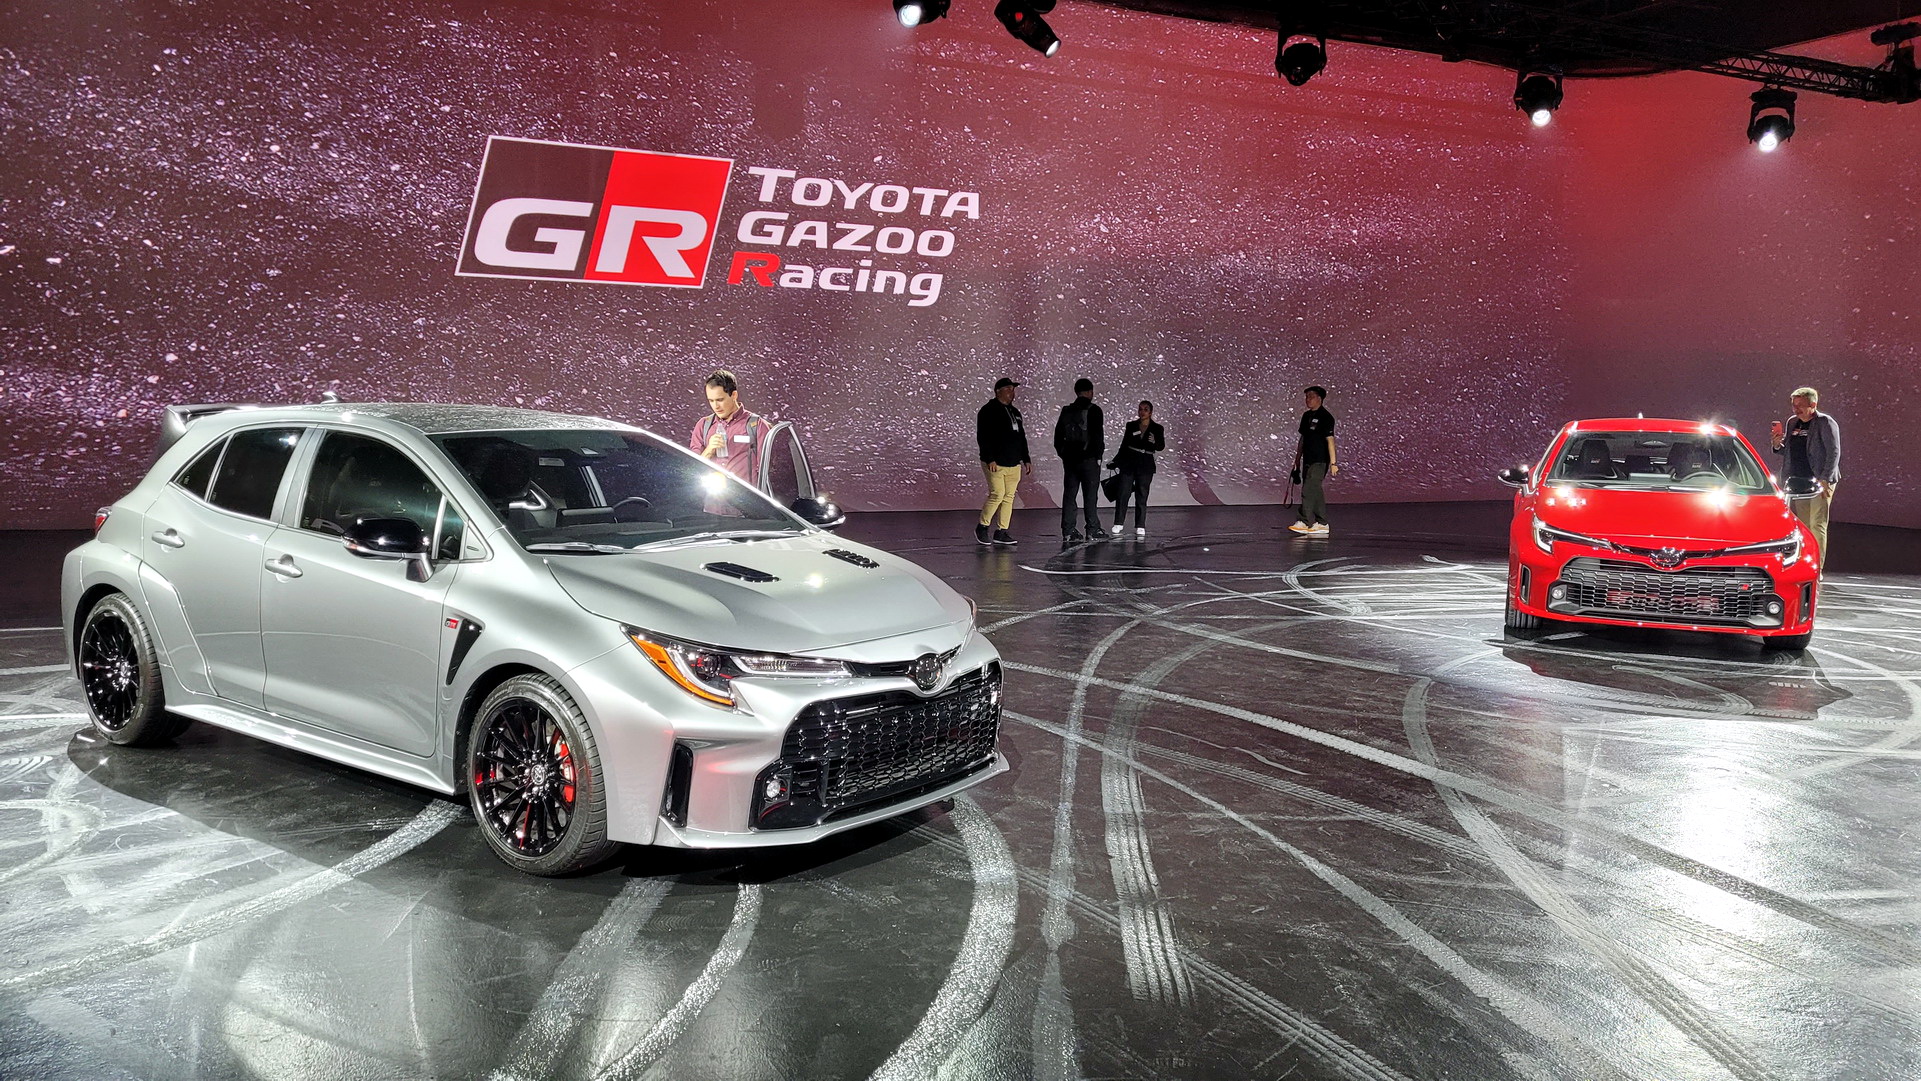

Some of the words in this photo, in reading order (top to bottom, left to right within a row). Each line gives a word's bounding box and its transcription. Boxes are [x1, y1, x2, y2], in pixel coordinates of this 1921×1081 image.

[748, 166, 980, 219] TOYOTA
[473, 198, 708, 278] GR
[735, 210, 955, 257] GAZOO
[727, 251, 944, 306] Racing
